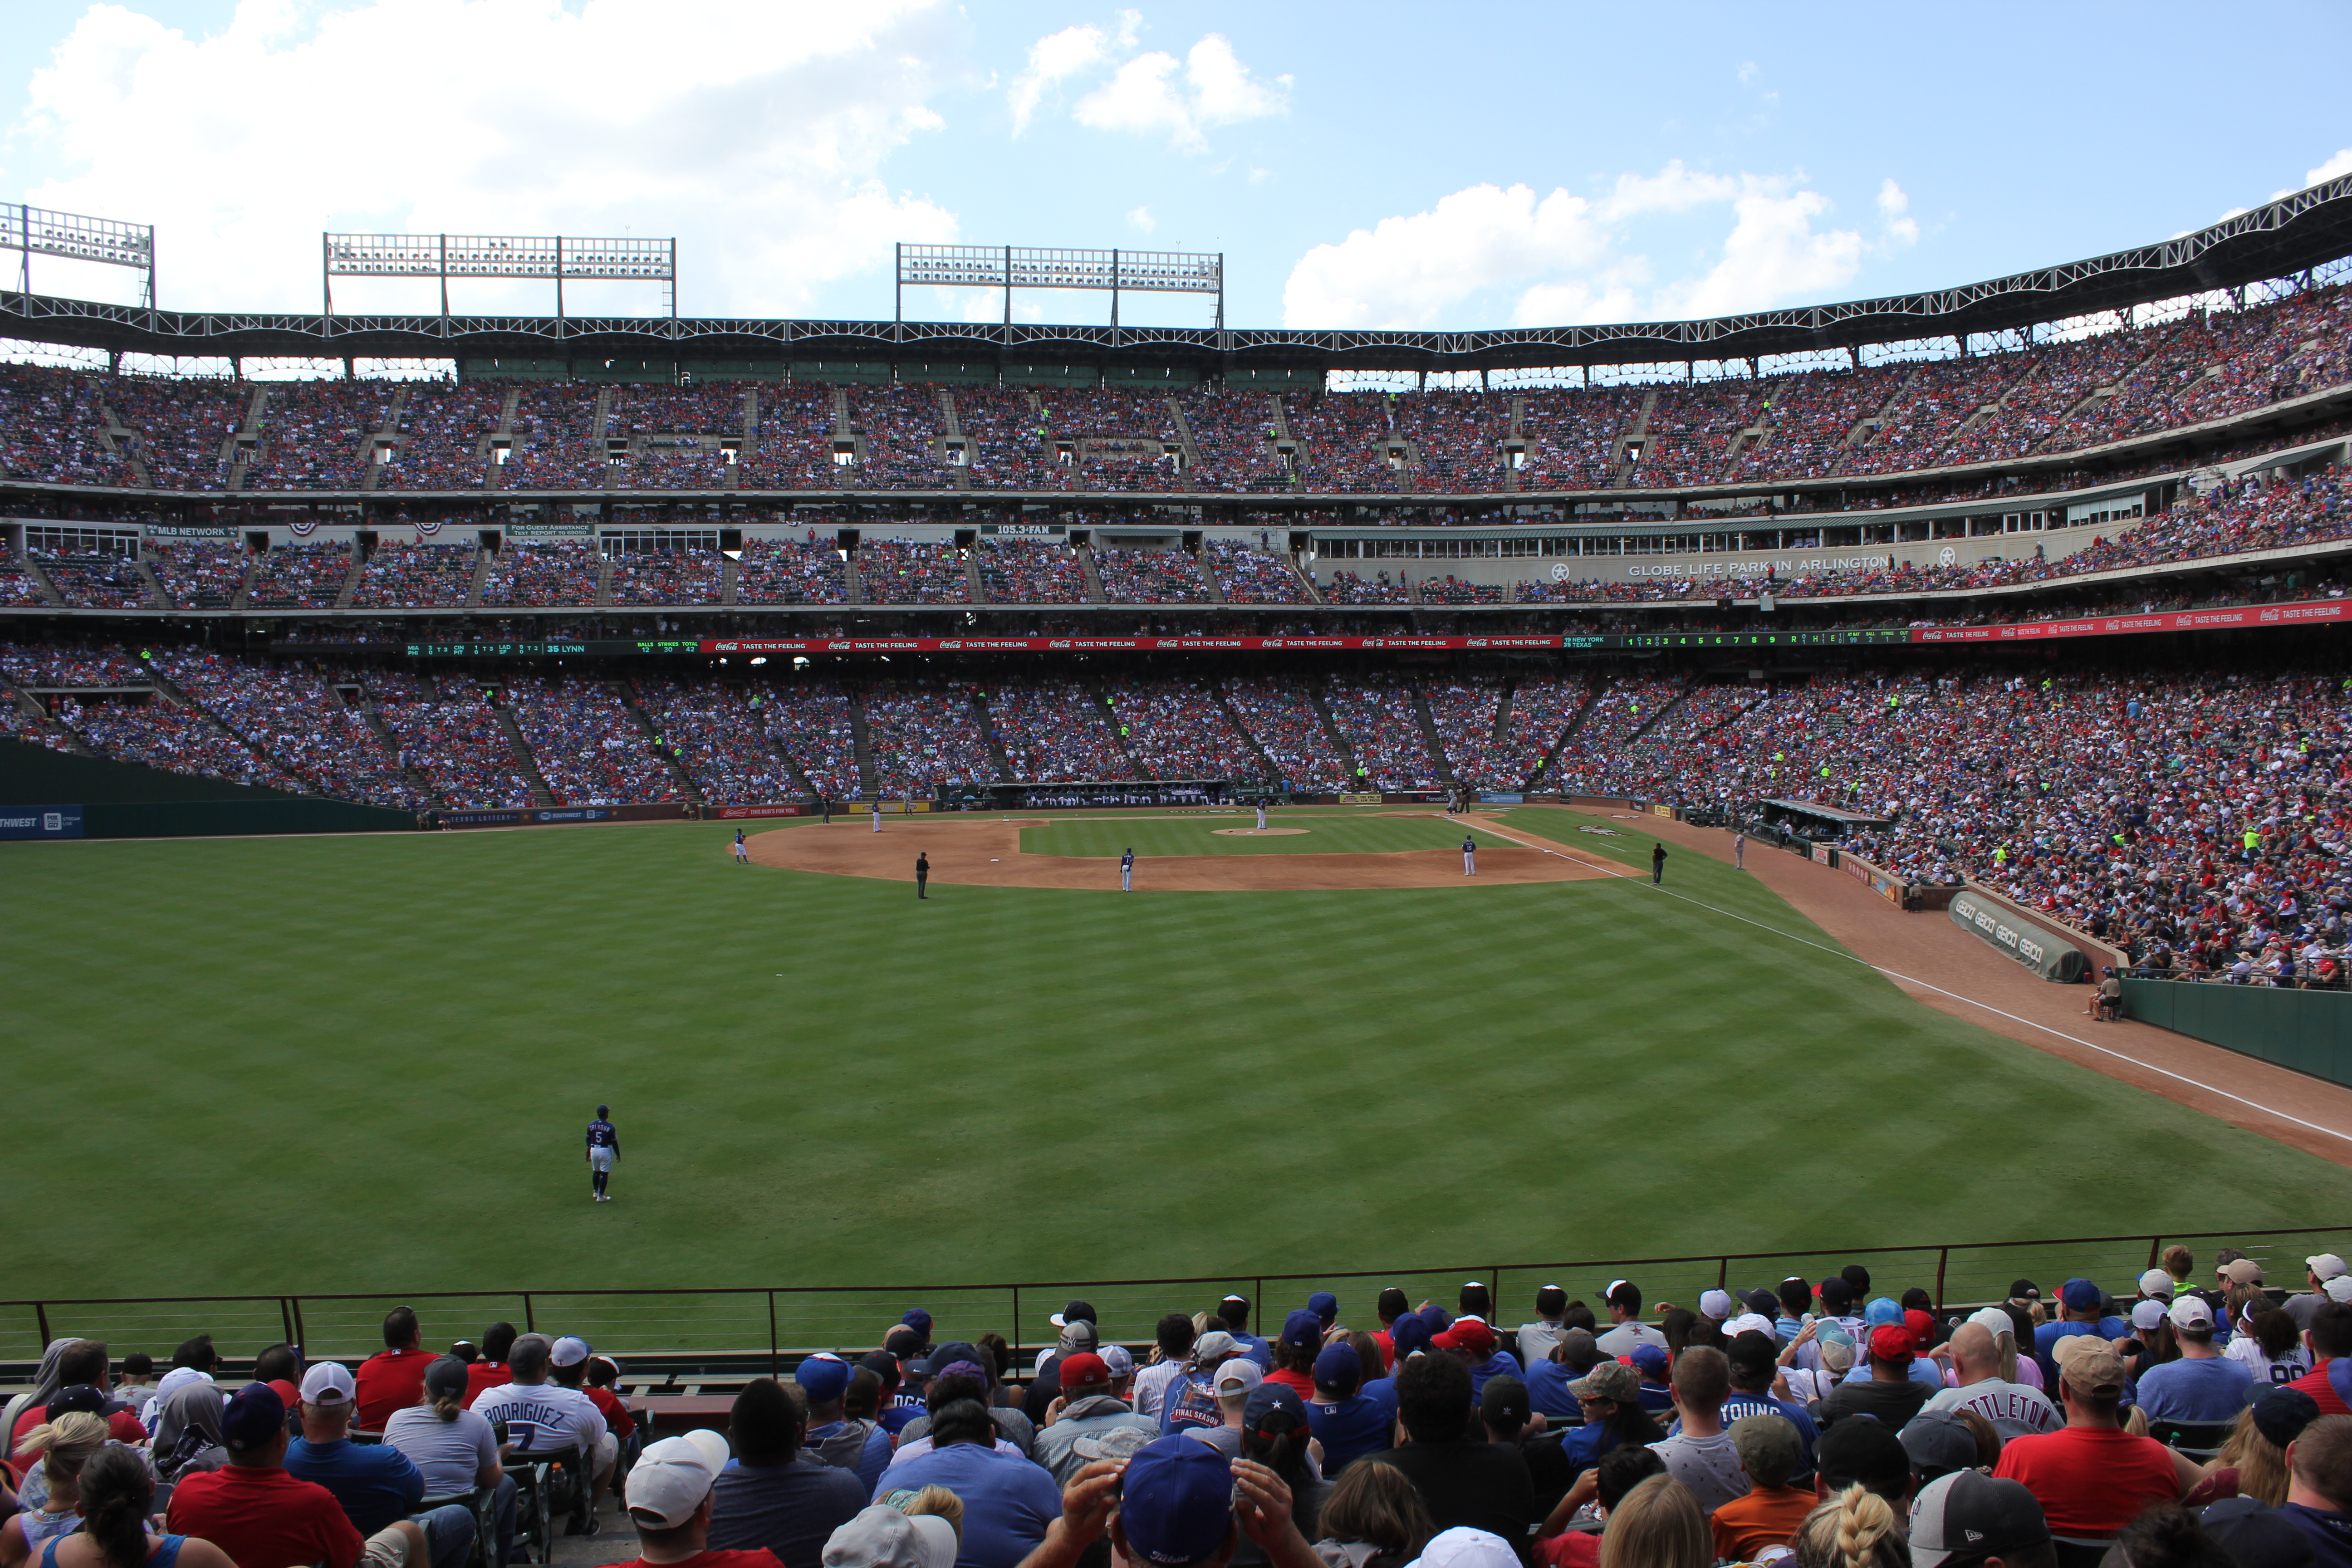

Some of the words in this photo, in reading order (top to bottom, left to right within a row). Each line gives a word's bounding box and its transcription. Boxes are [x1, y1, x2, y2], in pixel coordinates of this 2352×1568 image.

[158, 527, 177, 535] MLB
[180, 527, 225, 535] NETWORK
[998, 525, 1026, 534] 105.3
[1029, 525, 1049, 534] FAN
[1629, 565, 1682, 576] GLOBE
[1689, 563, 1723, 575] LIFE
[1729, 561, 1770, 573] PARK
[1775, 560, 1792, 572] IN
[1799, 556, 1889, 570] ARLINGTON
[2220, 613, 2243, 622] FEELING
[2283, 610, 2301, 618] TASTE
[2302, 609, 2314, 617] THE
[2314, 607, 2341, 617] FEELING
[2143, 619, 2161, 627] FEELING
[1955, 899, 1976, 920] GEICO
[1975, 911, 1997, 934] GEICO
[1995, 924, 2019, 949] GEICO
[2019, 937, 2045, 964] GEICO
[589, 1124, 611, 1132] CALHOUN
[596, 1132, 602, 1143] 5
[484, 1402, 565, 1430] RODRIGUEZ
[1175, 1408, 1193, 1418] FINAL
[1194, 1411, 1219, 1426] SEASON
[510, 1424, 535, 1451] 7
